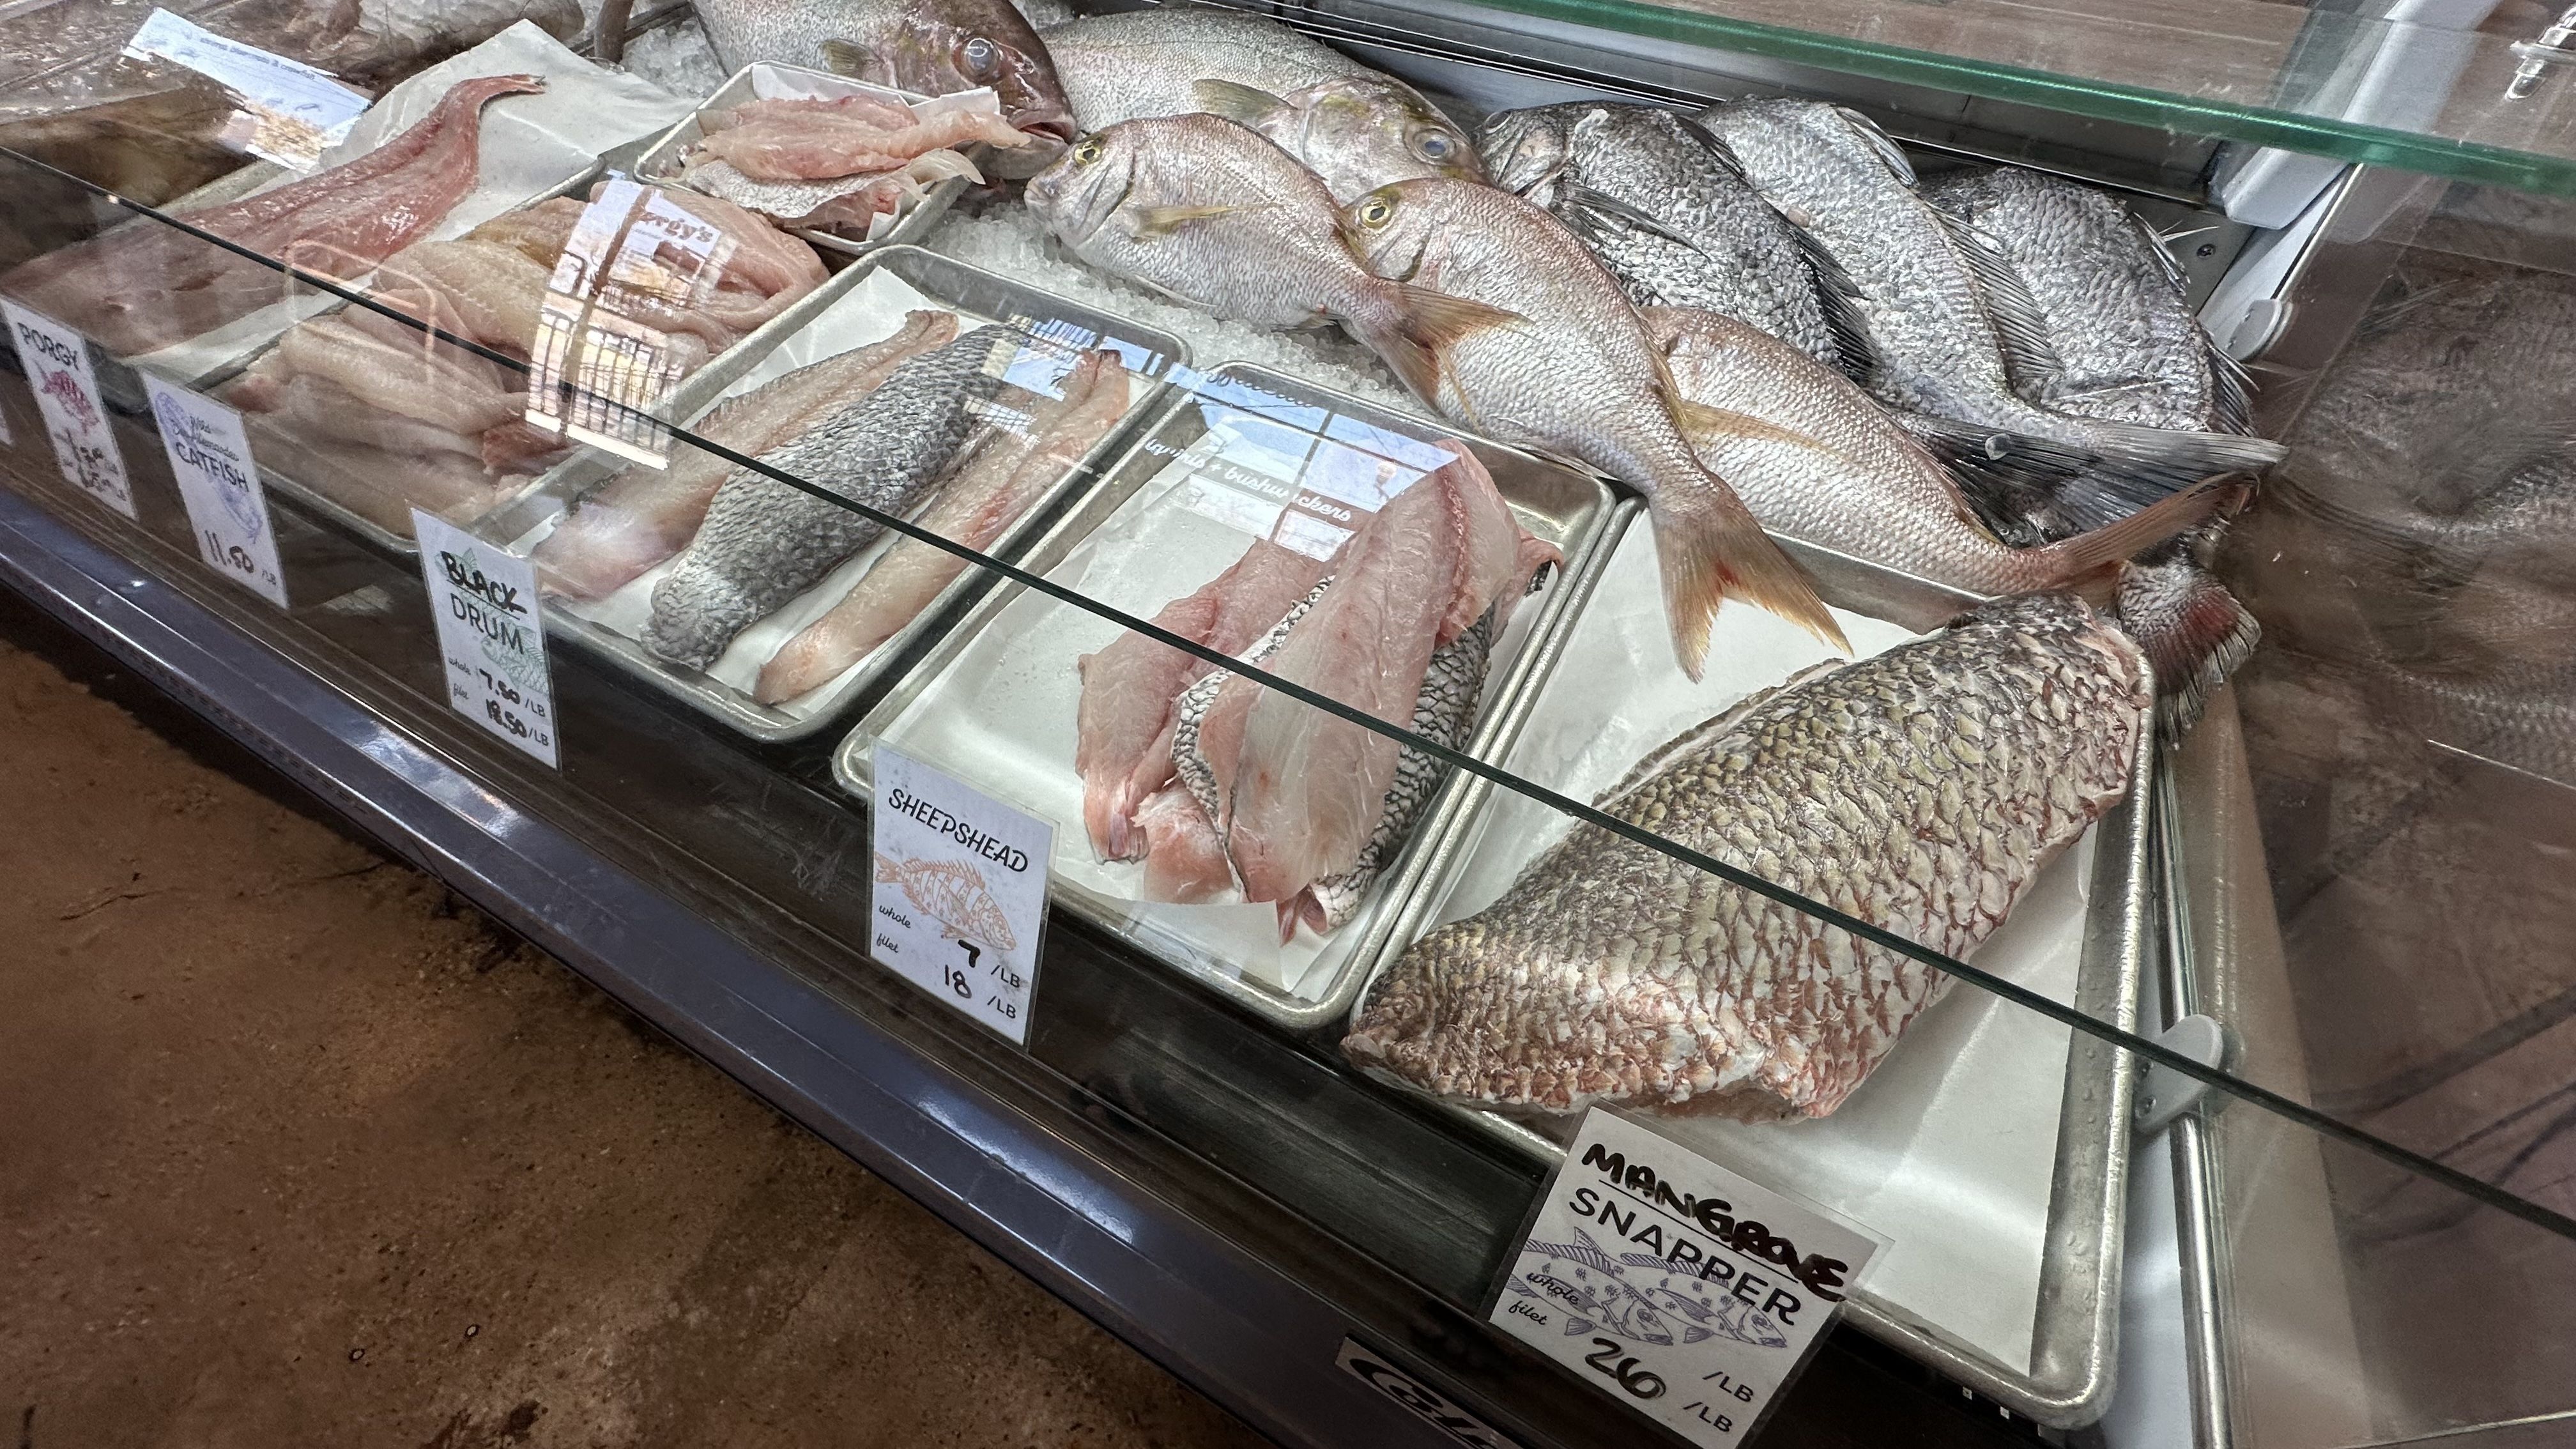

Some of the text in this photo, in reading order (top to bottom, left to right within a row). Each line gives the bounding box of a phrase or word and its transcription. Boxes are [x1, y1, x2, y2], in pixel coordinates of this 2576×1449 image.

[18, 322, 81, 371] PORGY
[176, 441, 249, 492] CATFISH
[440, 550, 527, 614] BLACK
[450, 593, 523, 654] DRUM
[448, 656, 471, 675] whole
[525, 698, 545, 717] /LB
[529, 728, 549, 746] /LB
[888, 788, 1028, 873] SHEEPSHEAD
[877, 933, 1017, 1019] filet 18 /LB
[878, 905, 1021, 988] whole 7 /LB
[1569, 1186, 1802, 1326] SNAPPER
[1581, 1143, 1848, 1302] MANGROVE
[1508, 1299, 1734, 1433] filet 26 /LB
[1526, 1272, 1756, 1404] whole /LB
